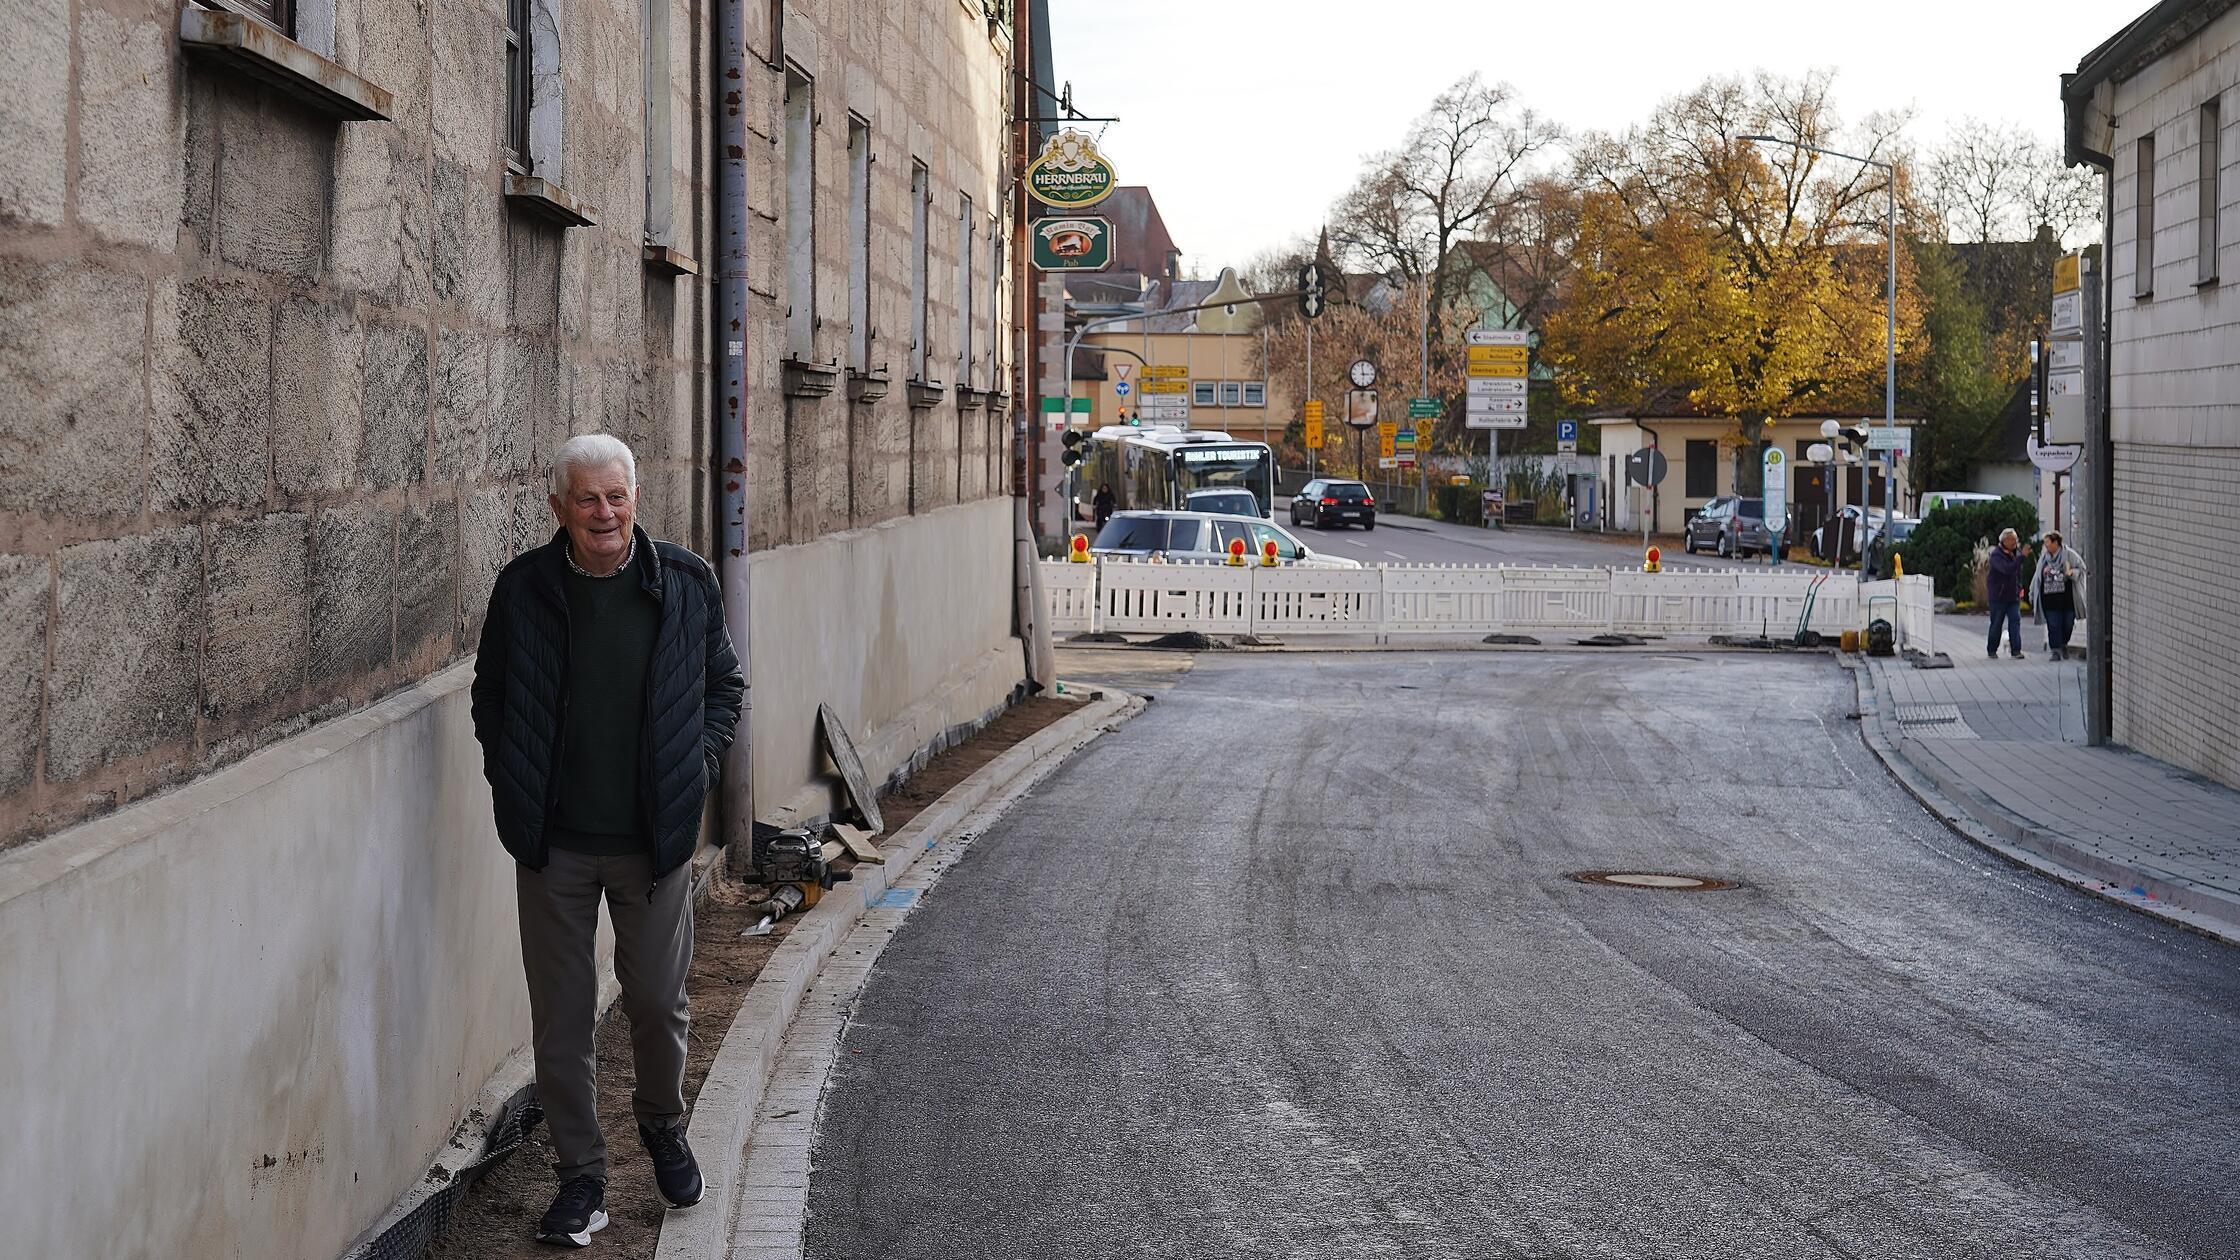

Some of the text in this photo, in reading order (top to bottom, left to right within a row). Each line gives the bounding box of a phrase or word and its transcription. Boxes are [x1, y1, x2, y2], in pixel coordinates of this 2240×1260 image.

[1035, 173, 1106, 185] HERRNBRÄU
[1064, 258, 1079, 267] Pub
[1561, 423, 1573, 438] P
